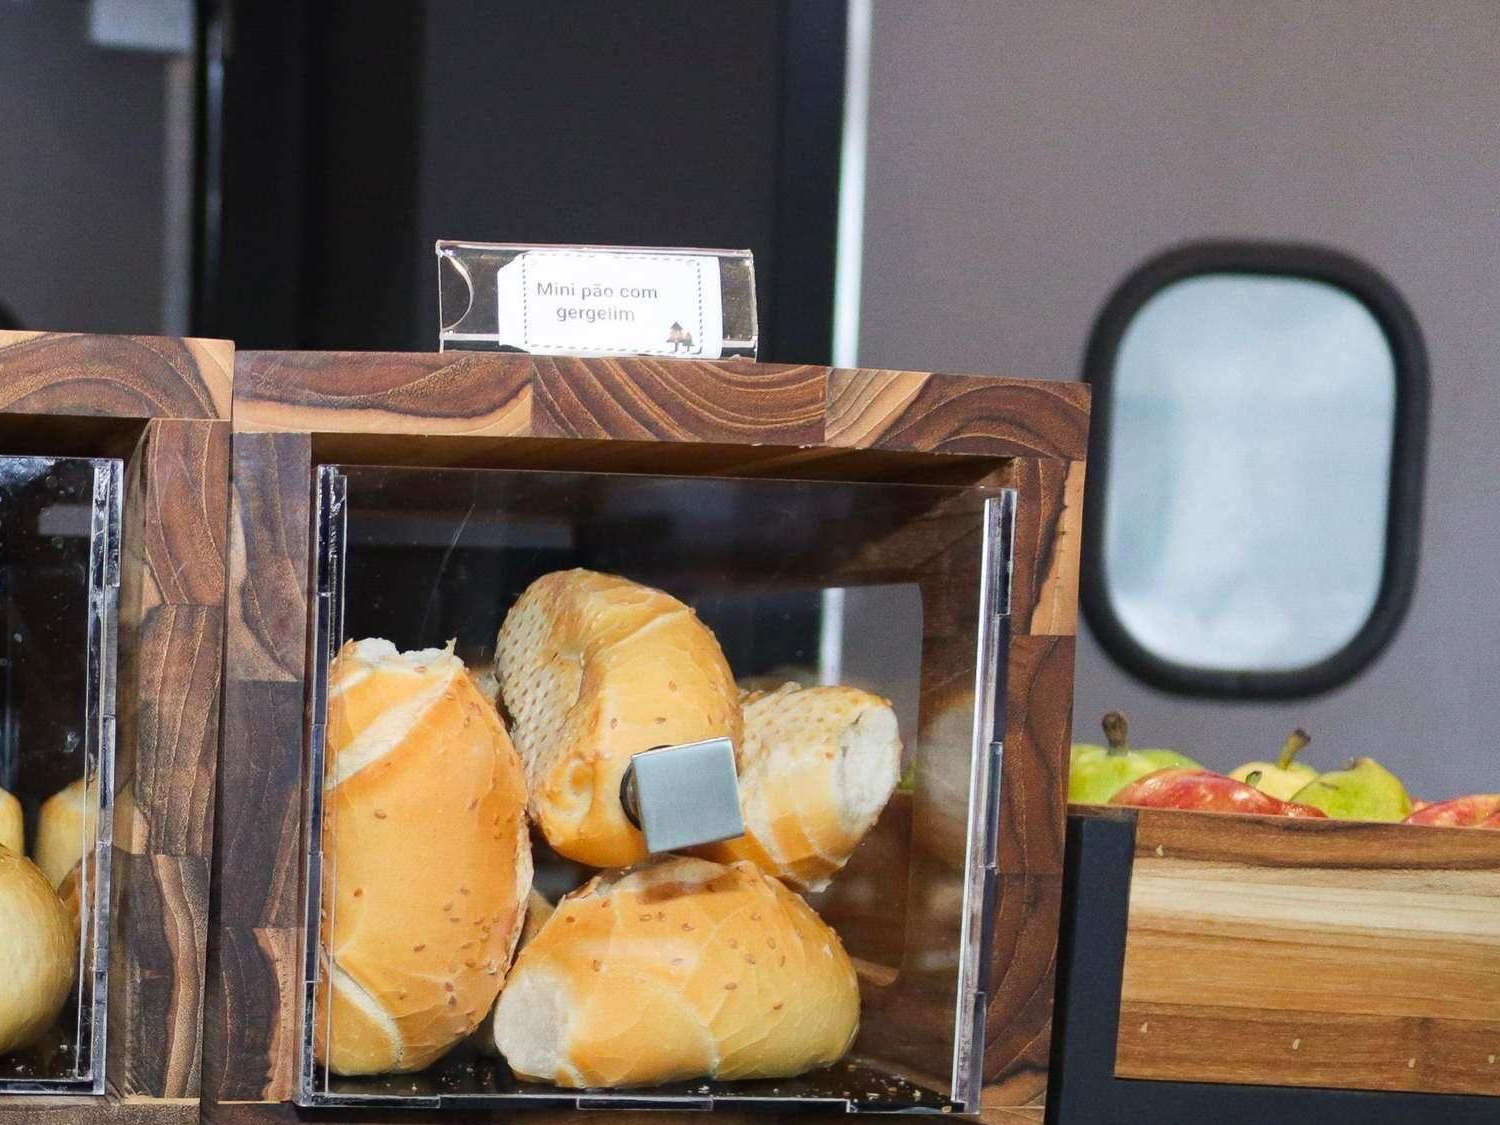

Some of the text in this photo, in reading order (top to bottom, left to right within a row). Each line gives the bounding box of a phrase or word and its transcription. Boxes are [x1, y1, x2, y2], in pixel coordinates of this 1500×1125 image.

[537, 281, 658, 300] Mini pão com
[556, 303, 635, 323] gergelim
